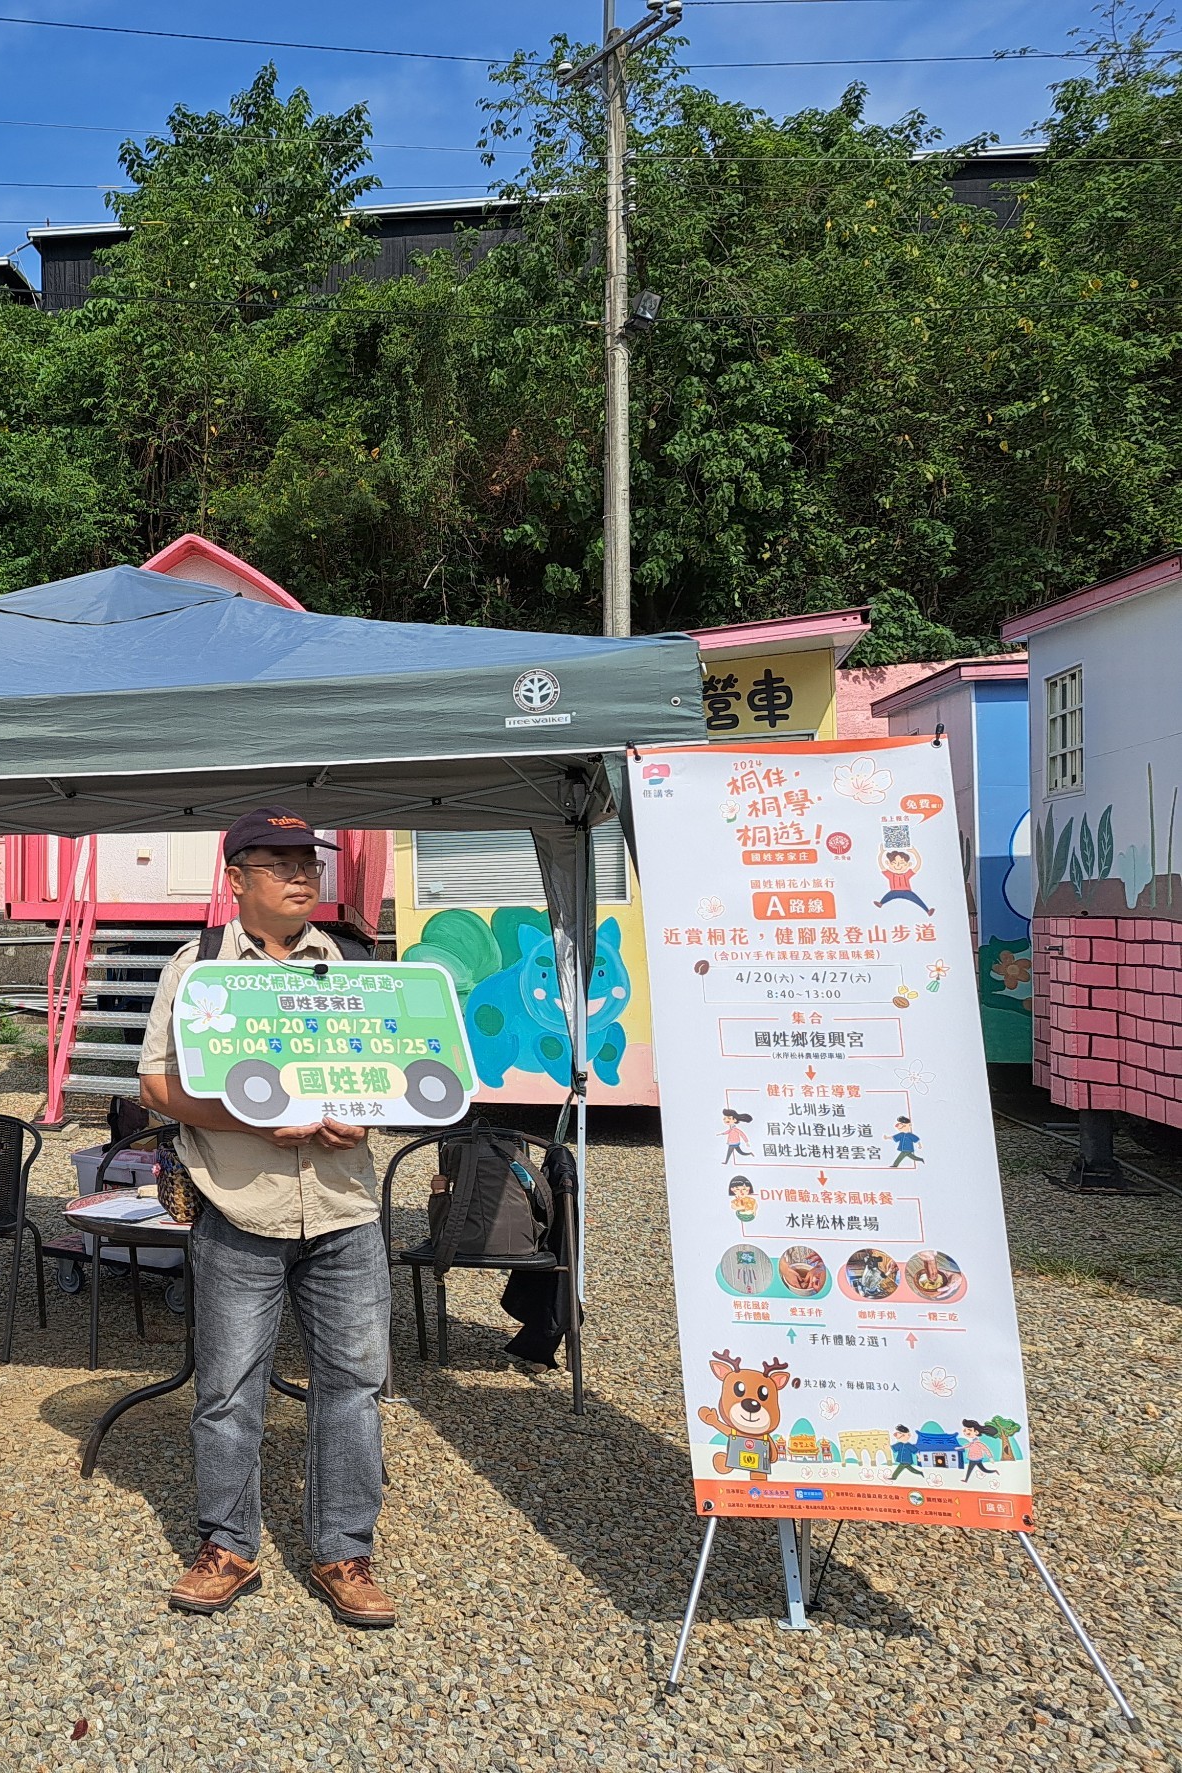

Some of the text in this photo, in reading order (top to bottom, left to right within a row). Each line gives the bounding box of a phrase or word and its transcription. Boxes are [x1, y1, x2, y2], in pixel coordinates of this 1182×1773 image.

[703, 668, 793, 731] 營車
[733, 760, 762, 770] 2024
[751, 852, 810, 862] 國姓客家庄
[750, 878, 836, 890] 國姓桐花小旅行
[279, 996, 364, 1011] 國姓客家庄
[791, 1011, 823, 1025] 集合
[754, 1031, 864, 1048] 國姓鄉復興宮
[297, 1066, 391, 1095] 國姓鄉
[767, 1084, 861, 1098] 健行 客庄導覽
[321, 1101, 385, 1118] 共5梯次
[788, 1103, 846, 1118] 北圳步道
[763, 1143, 881, 1160] 國姓北港村碧雲宮
[760, 1189, 894, 1206] DIY體驗及客家風味餐
[785, 1212, 879, 1232] 水岸松林農場
